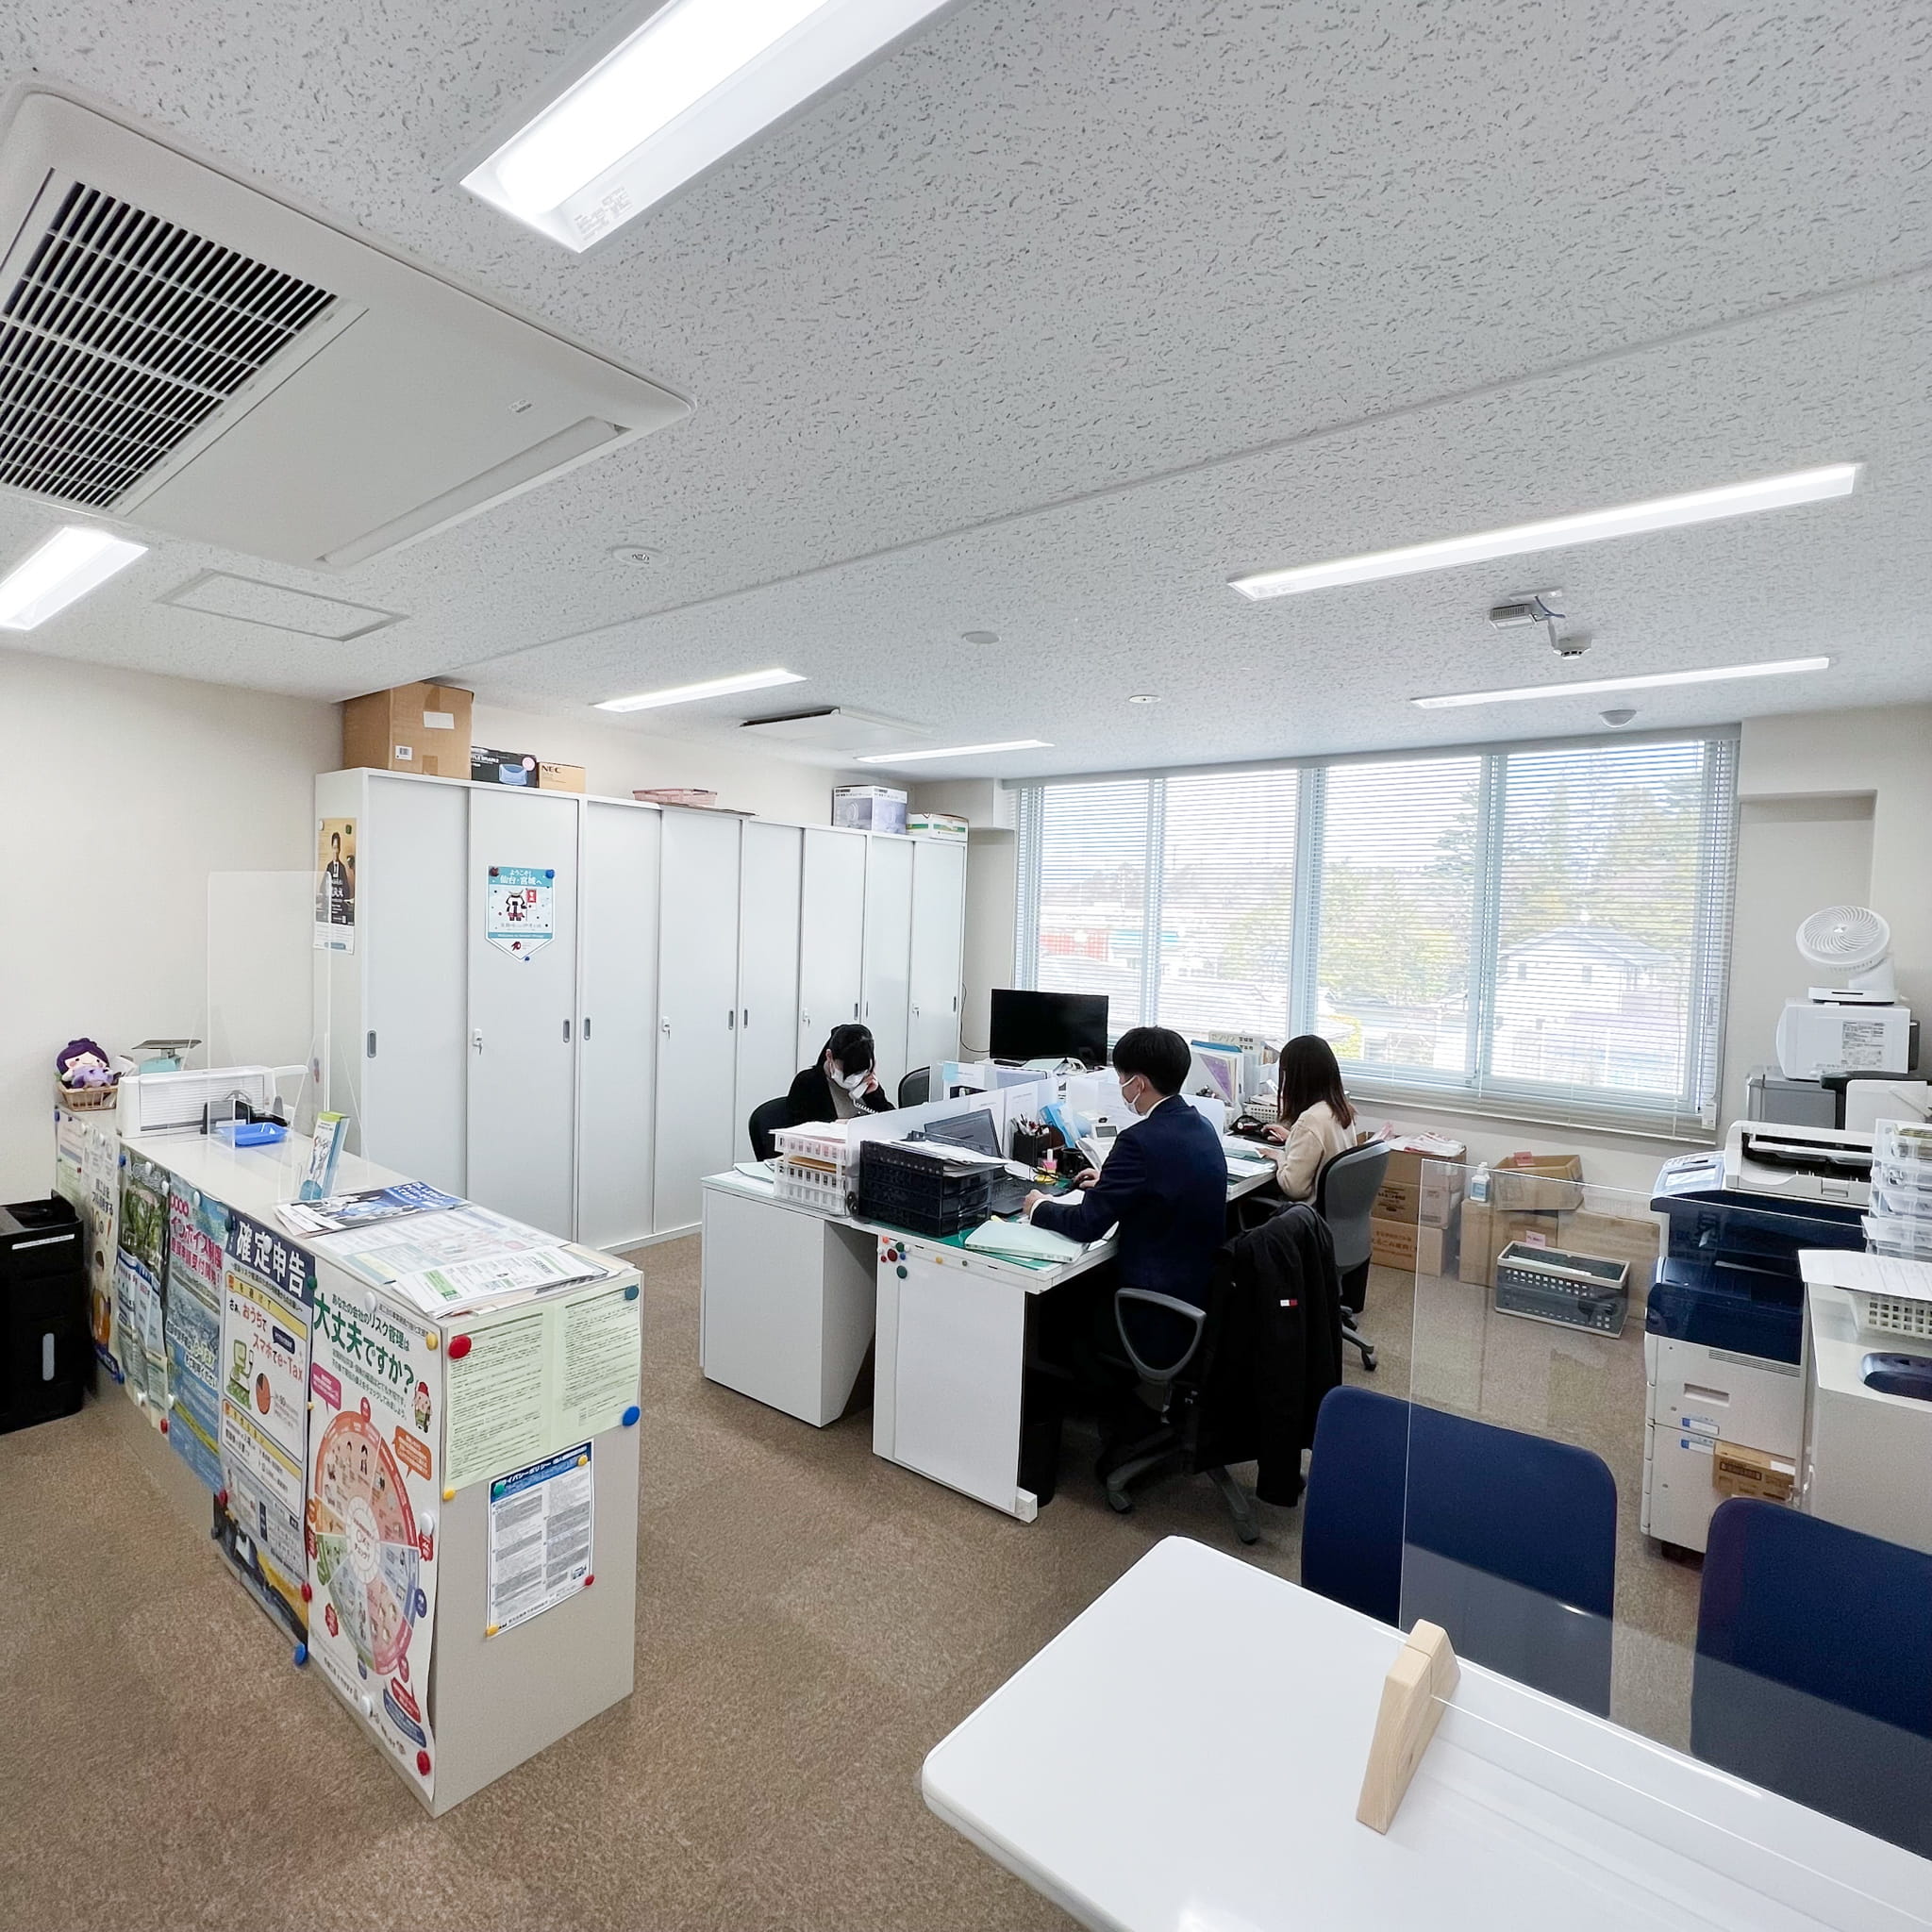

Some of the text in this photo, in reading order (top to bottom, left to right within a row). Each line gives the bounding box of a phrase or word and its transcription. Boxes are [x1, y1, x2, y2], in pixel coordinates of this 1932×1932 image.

[541, 765, 561, 774] NEC
[237, 1221, 306, 1298] 確定申告
[332, 1293, 410, 1352] あなたの会社のリスク管理は
